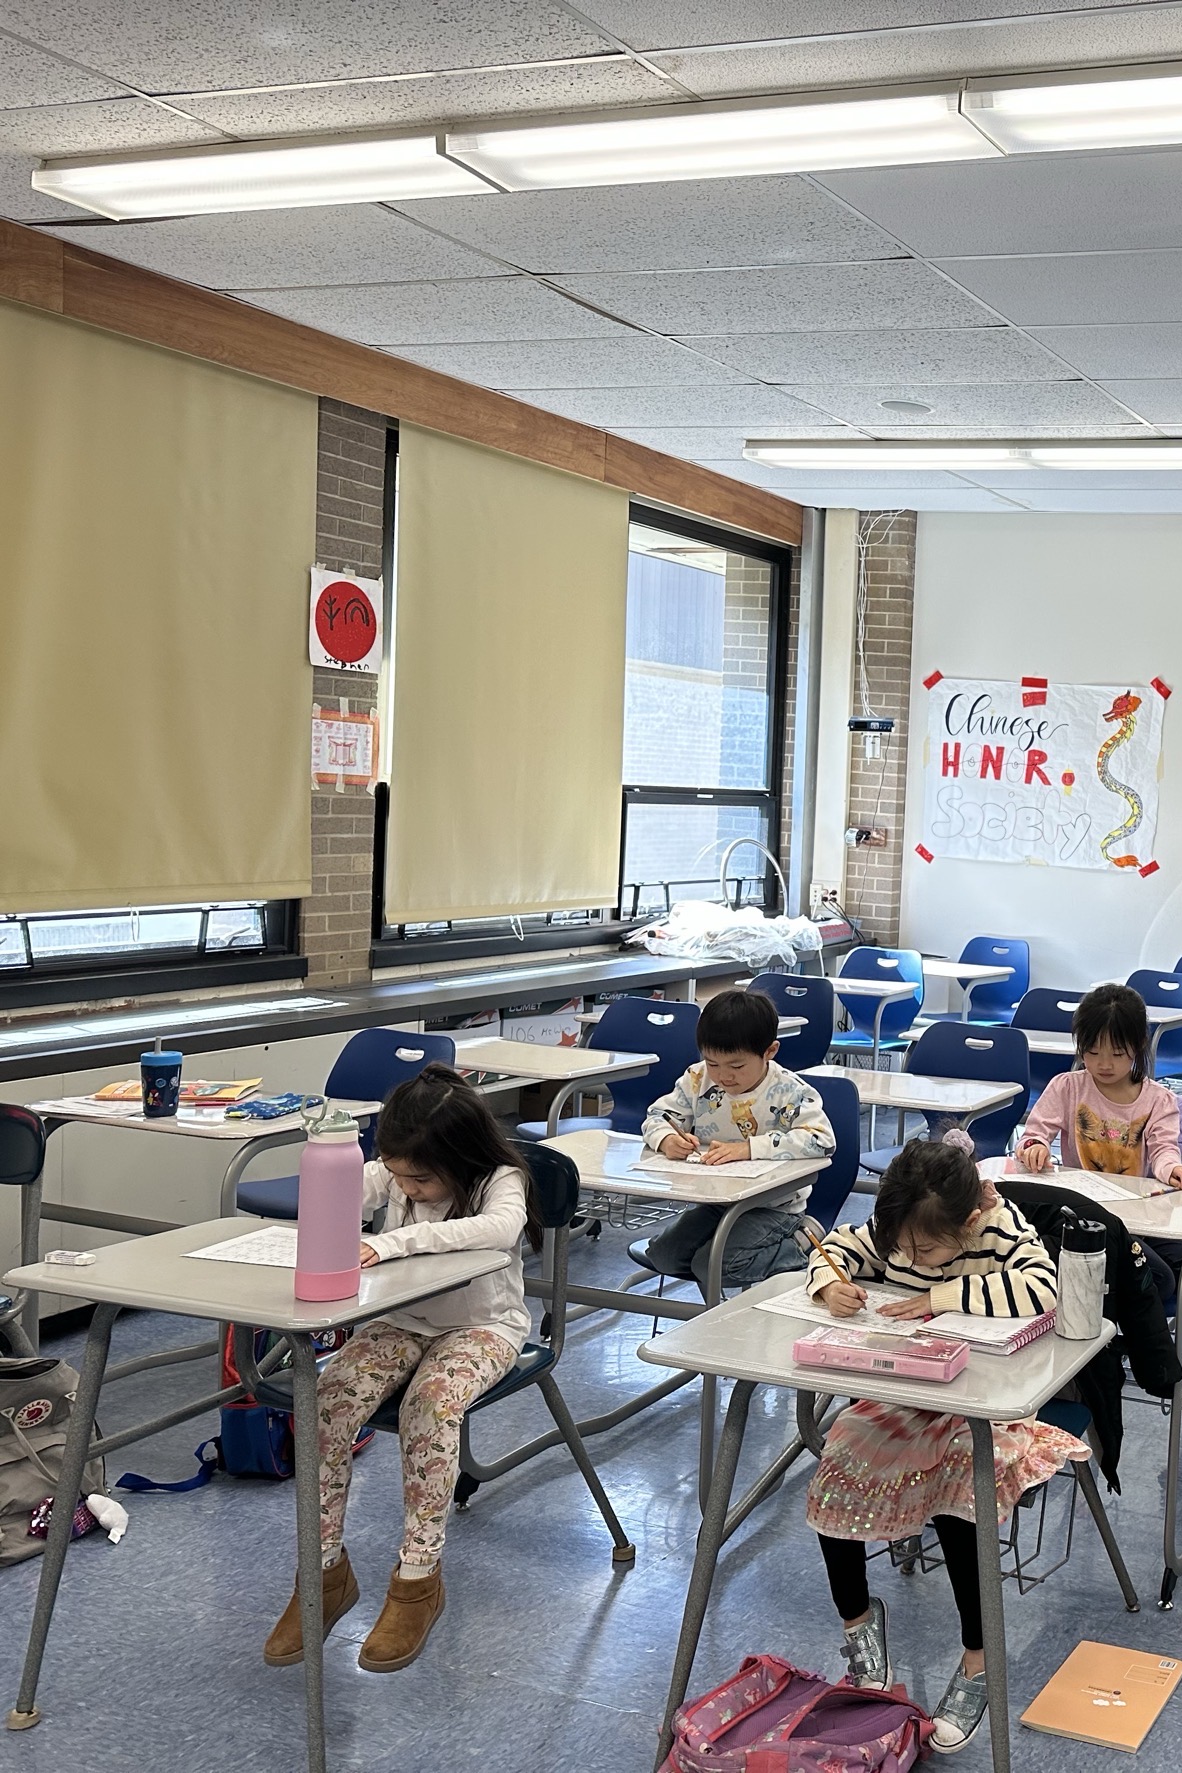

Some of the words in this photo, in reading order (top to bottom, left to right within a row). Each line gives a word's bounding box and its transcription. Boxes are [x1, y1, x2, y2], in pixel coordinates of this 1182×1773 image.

[944, 693, 1069, 751] Chinese
[941, 742, 1052, 786] HONOR
[600, 992, 628, 1000] COMET
[510, 1026, 535, 1042] 106
